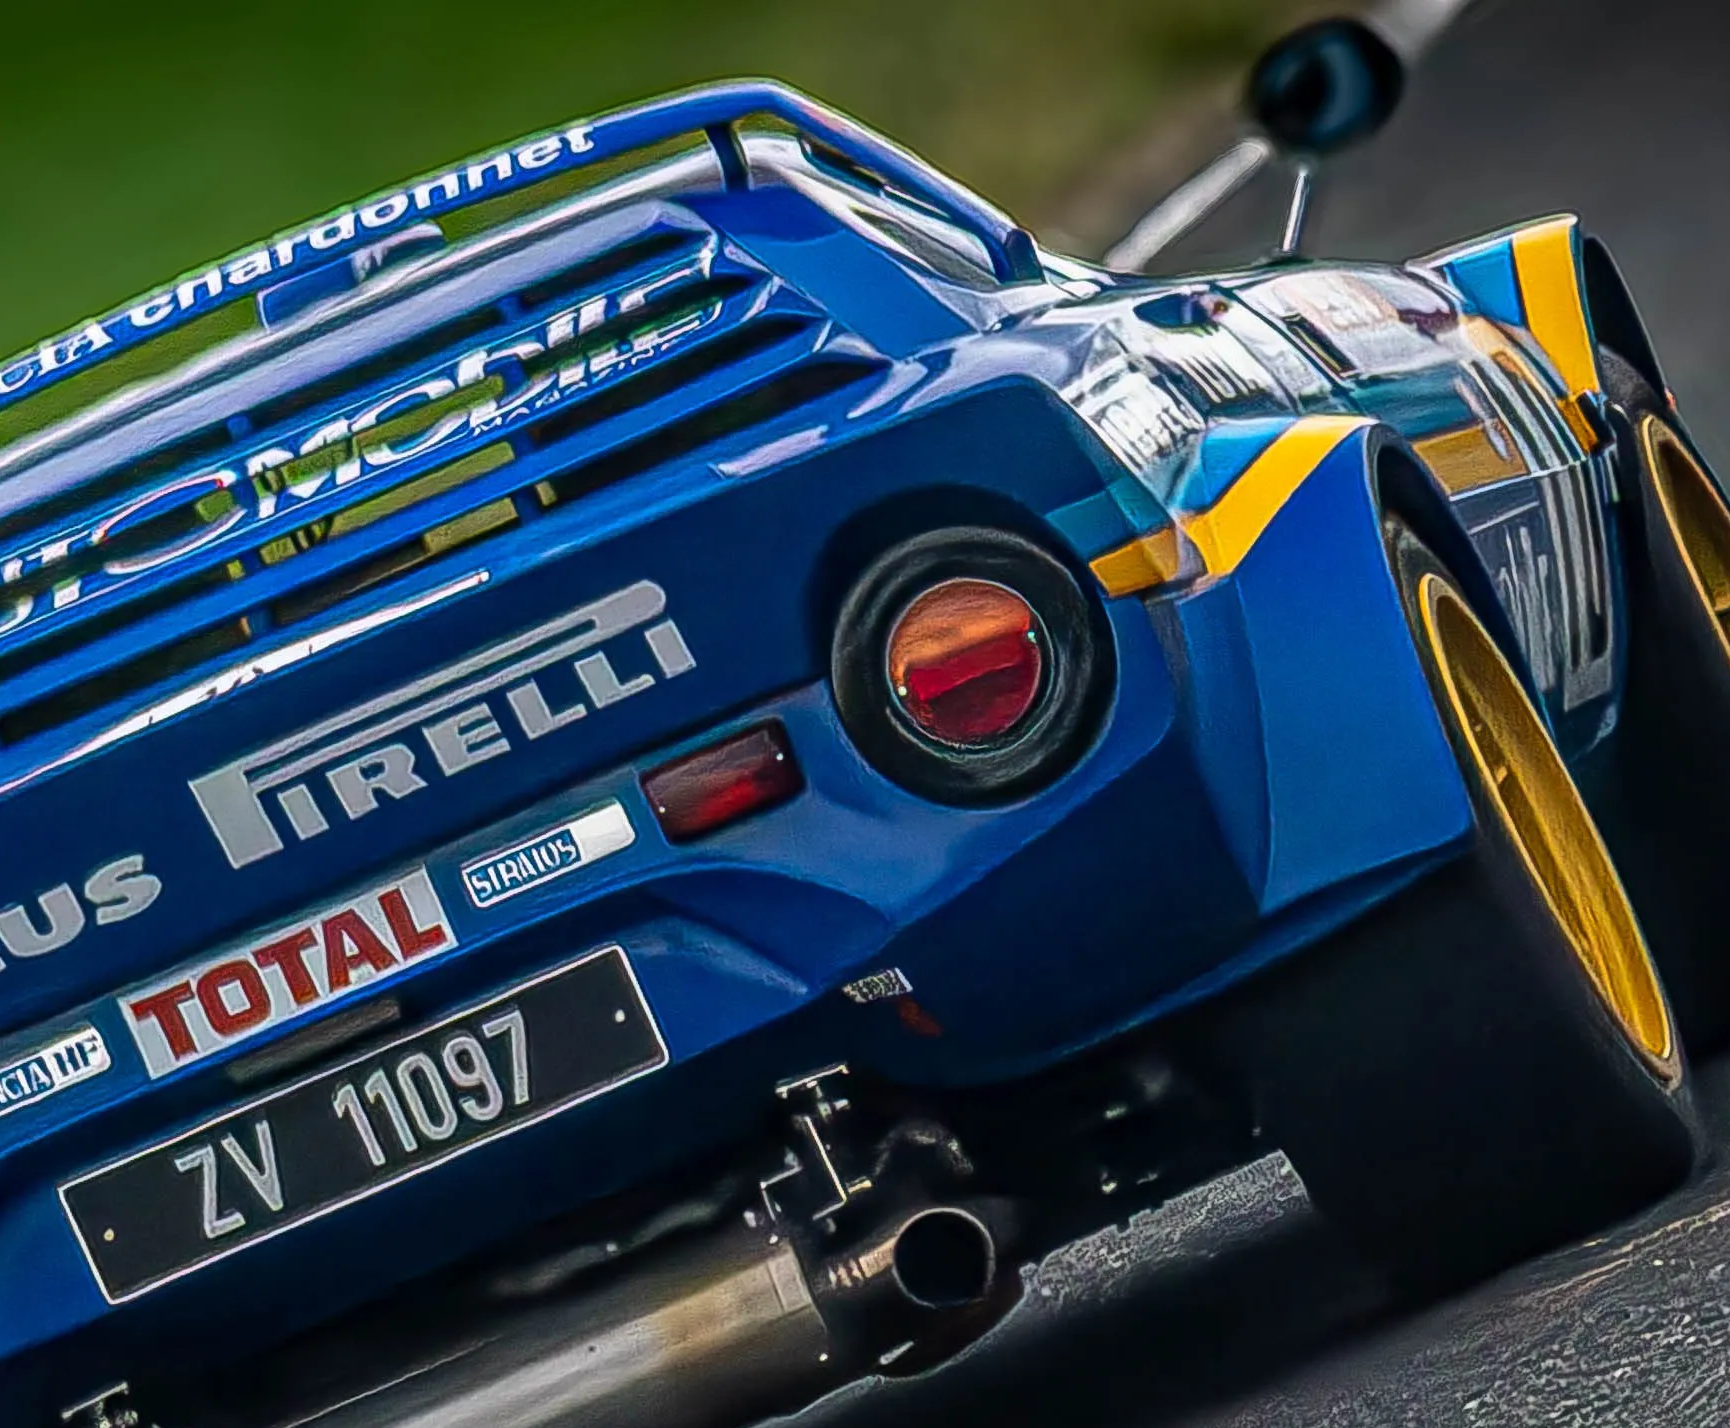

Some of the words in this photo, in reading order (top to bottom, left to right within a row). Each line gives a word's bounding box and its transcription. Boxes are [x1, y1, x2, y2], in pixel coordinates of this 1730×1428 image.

[128, 121, 596, 330] chardonnet
[188, 579, 697, 870] PIRELLI
[130, 887, 448, 1061] TOTAL
[175, 1121, 285, 1239] ZV
[334, 1011, 530, 1167] 11097
